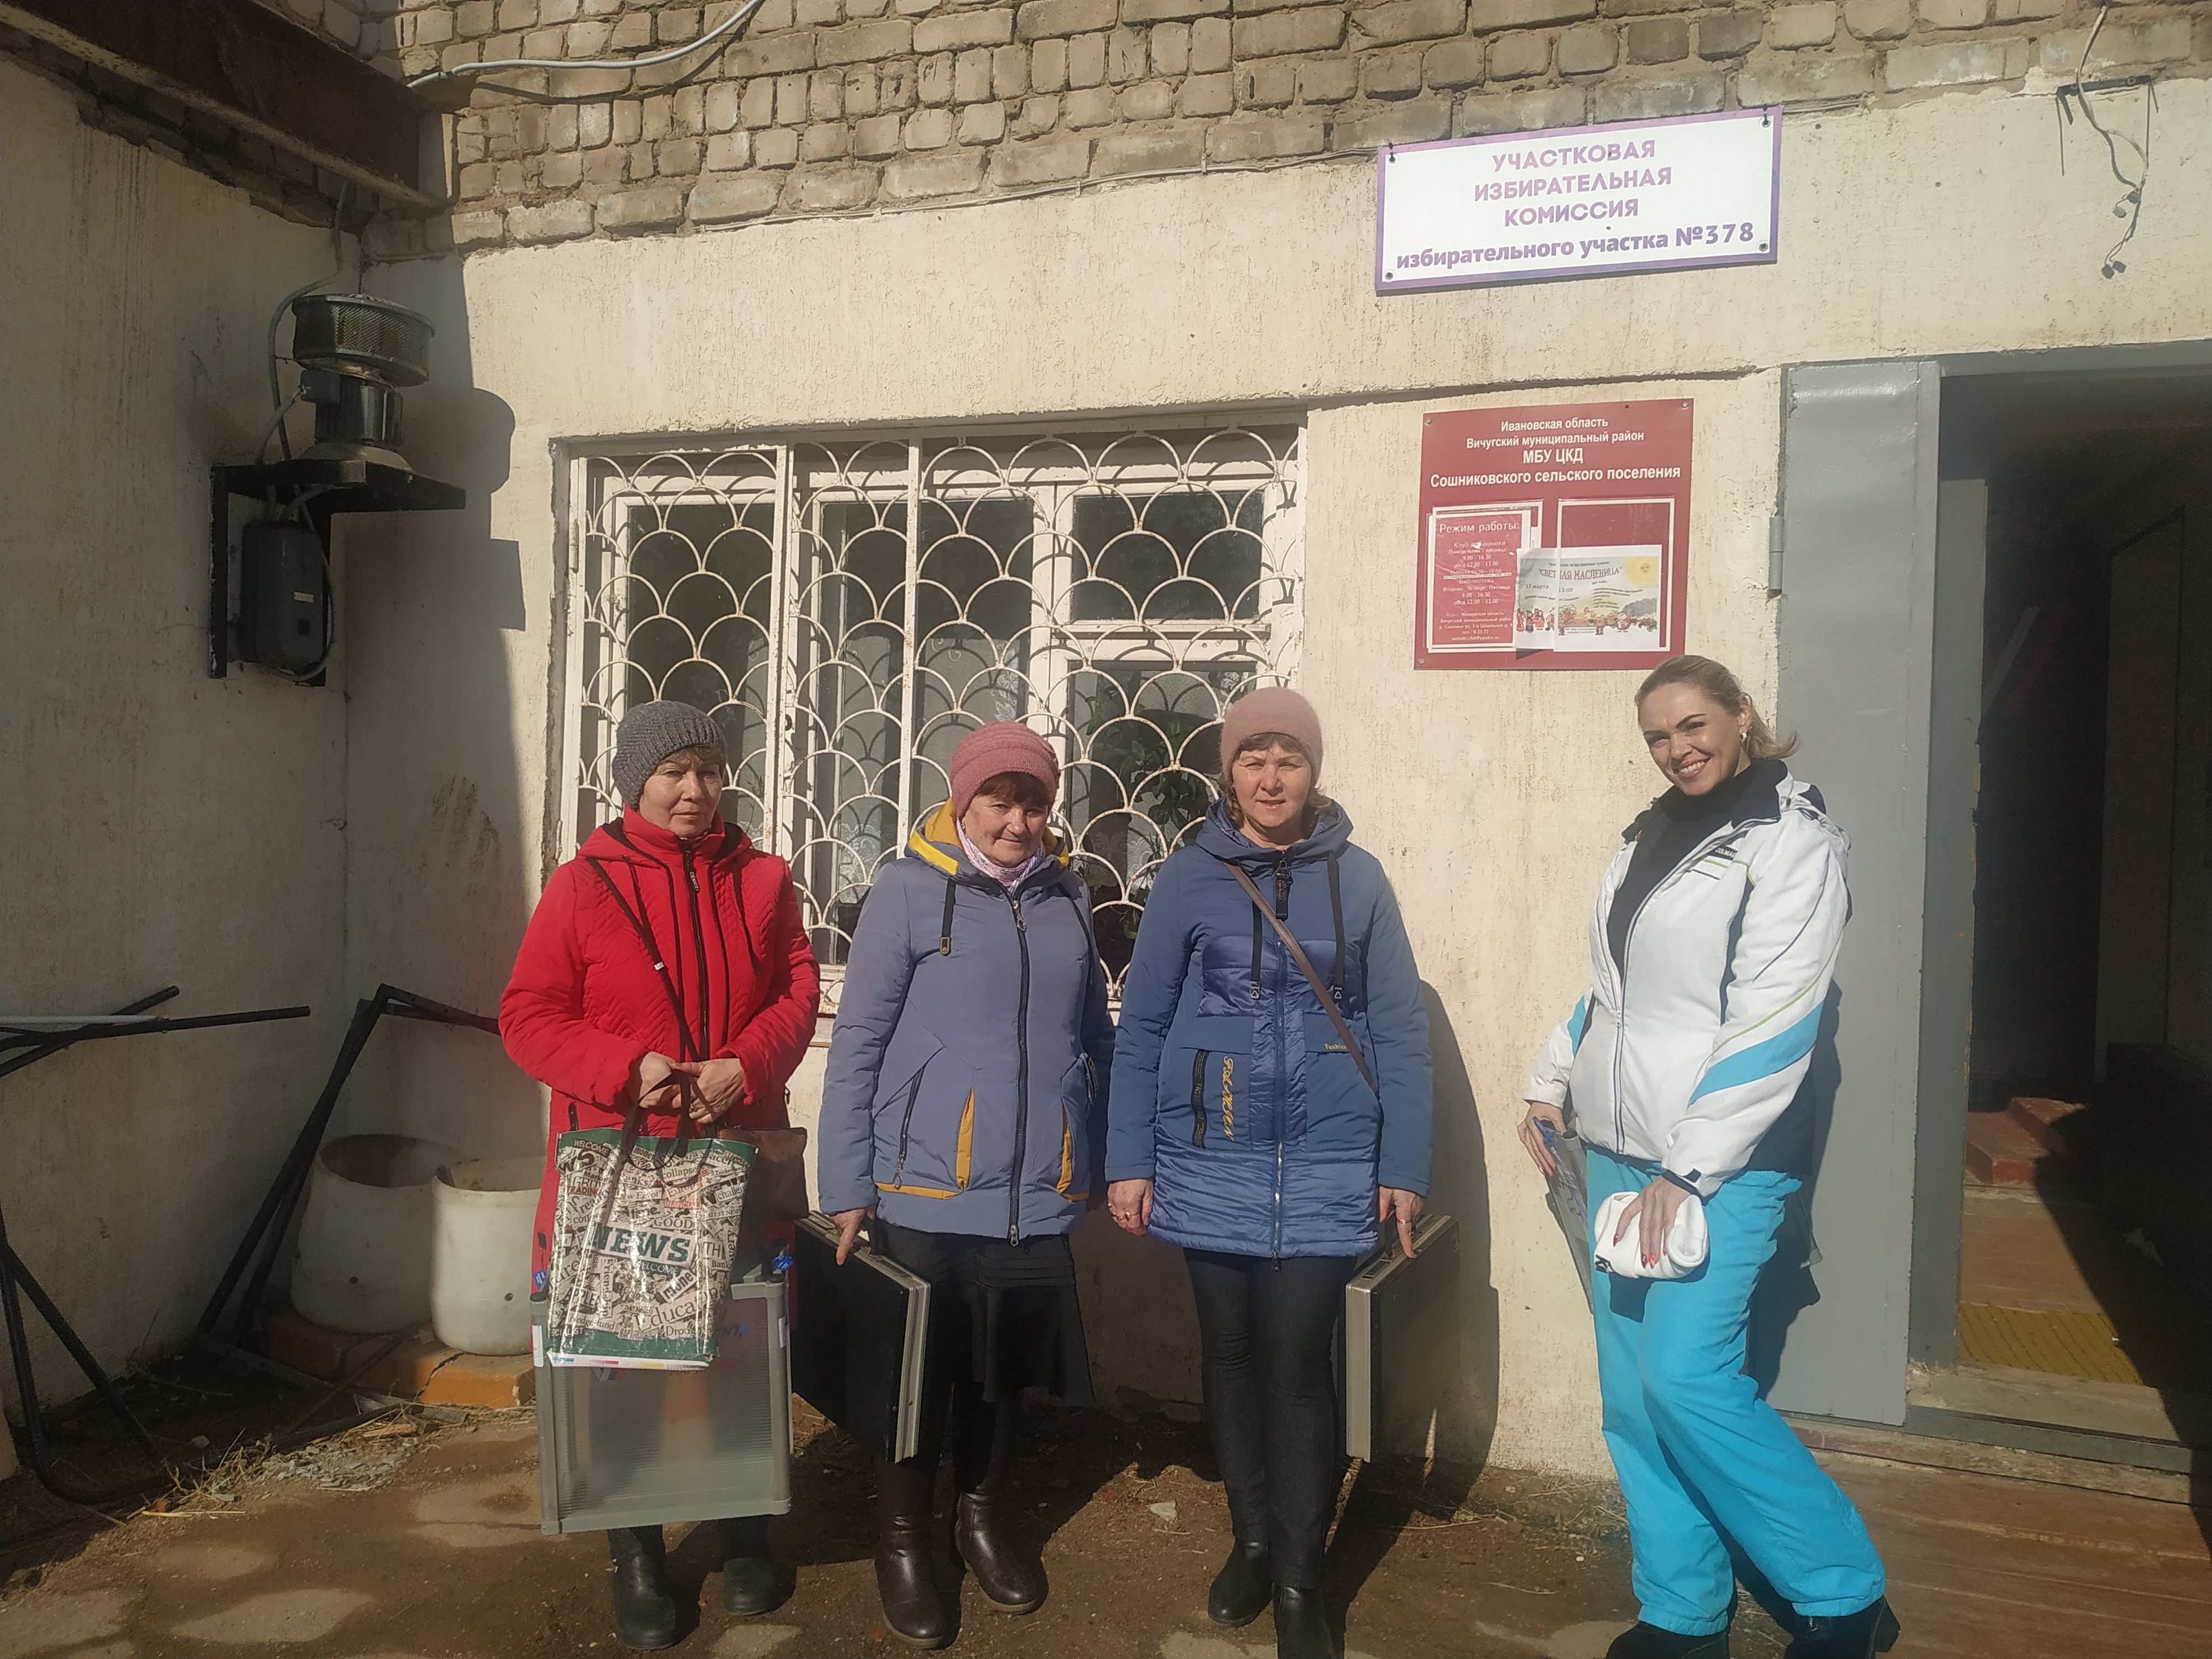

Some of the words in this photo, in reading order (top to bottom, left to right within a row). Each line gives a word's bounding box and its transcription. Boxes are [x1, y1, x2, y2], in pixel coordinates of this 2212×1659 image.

[1492, 140, 1655, 171] УЧАСТКОВАЯ
[1474, 167, 1672, 202] ИЗБИРАТЕЛЬНАЯ
[1504, 199, 1639, 227] КОМИССИЯ
[1397, 242, 1574, 272] избирательного
[1580, 233, 1668, 258] участка
[1501, 419, 1562, 432] Ивановская
[1565, 418, 1609, 429] область
[1467, 435, 1519, 450] Вичугский
[1522, 432, 1609, 447] муниципальный
[1611, 431, 1645, 443] район
[1523, 450, 1552, 464] МБУ
[1556, 448, 1584, 464] ЦКД
[1431, 472, 1531, 488] Сошниковского
[1535, 469, 1603, 483] сельского
[1607, 466, 1681, 480] поселения
[1439, 524, 1475, 534] Режим
[1479, 521, 1520, 534] работы:
[574, 1139, 609, 1156] WELCOME
[654, 1217, 693, 1229] GOOD
[587, 1222, 691, 1262] NEWS
